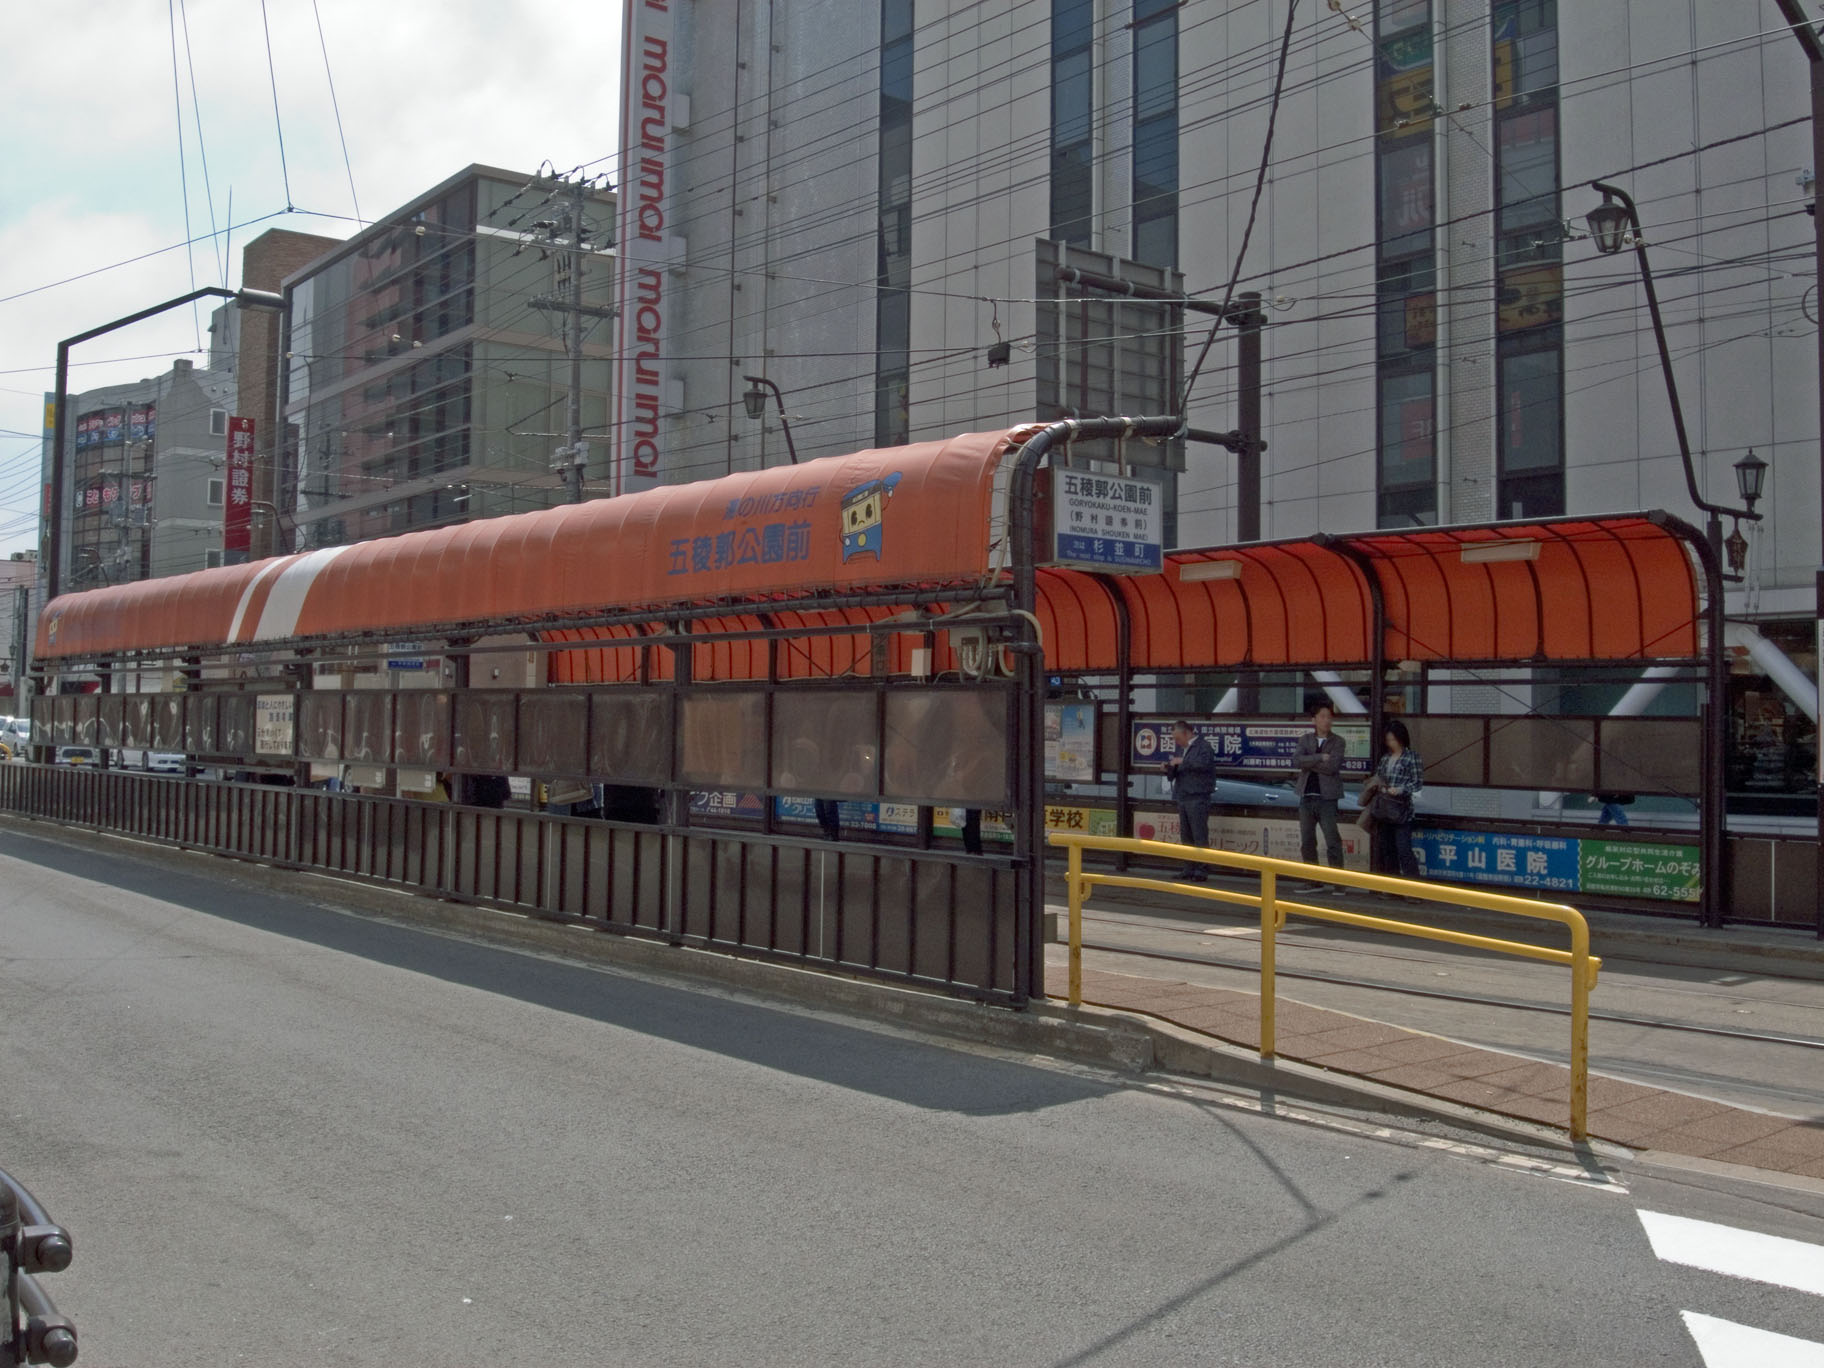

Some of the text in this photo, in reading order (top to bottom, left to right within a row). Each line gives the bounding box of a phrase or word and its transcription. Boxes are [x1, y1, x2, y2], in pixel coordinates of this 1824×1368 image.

[640, 35, 668, 153] marui
[637, 156, 665, 243] imai
[632, 266, 662, 479] marui imai
[1064, 475, 1152, 505] 五稜郭公園前
[1069, 498, 1149, 516] GORYOKAKU-KOEN-MAE
[667, 520, 812, 576] 五稜郭公園前
[1093, 539, 1145, 558] 杉並町
[1045, 808, 1084, 829] 学校
[1438, 844, 1549, 875] 平山医院
